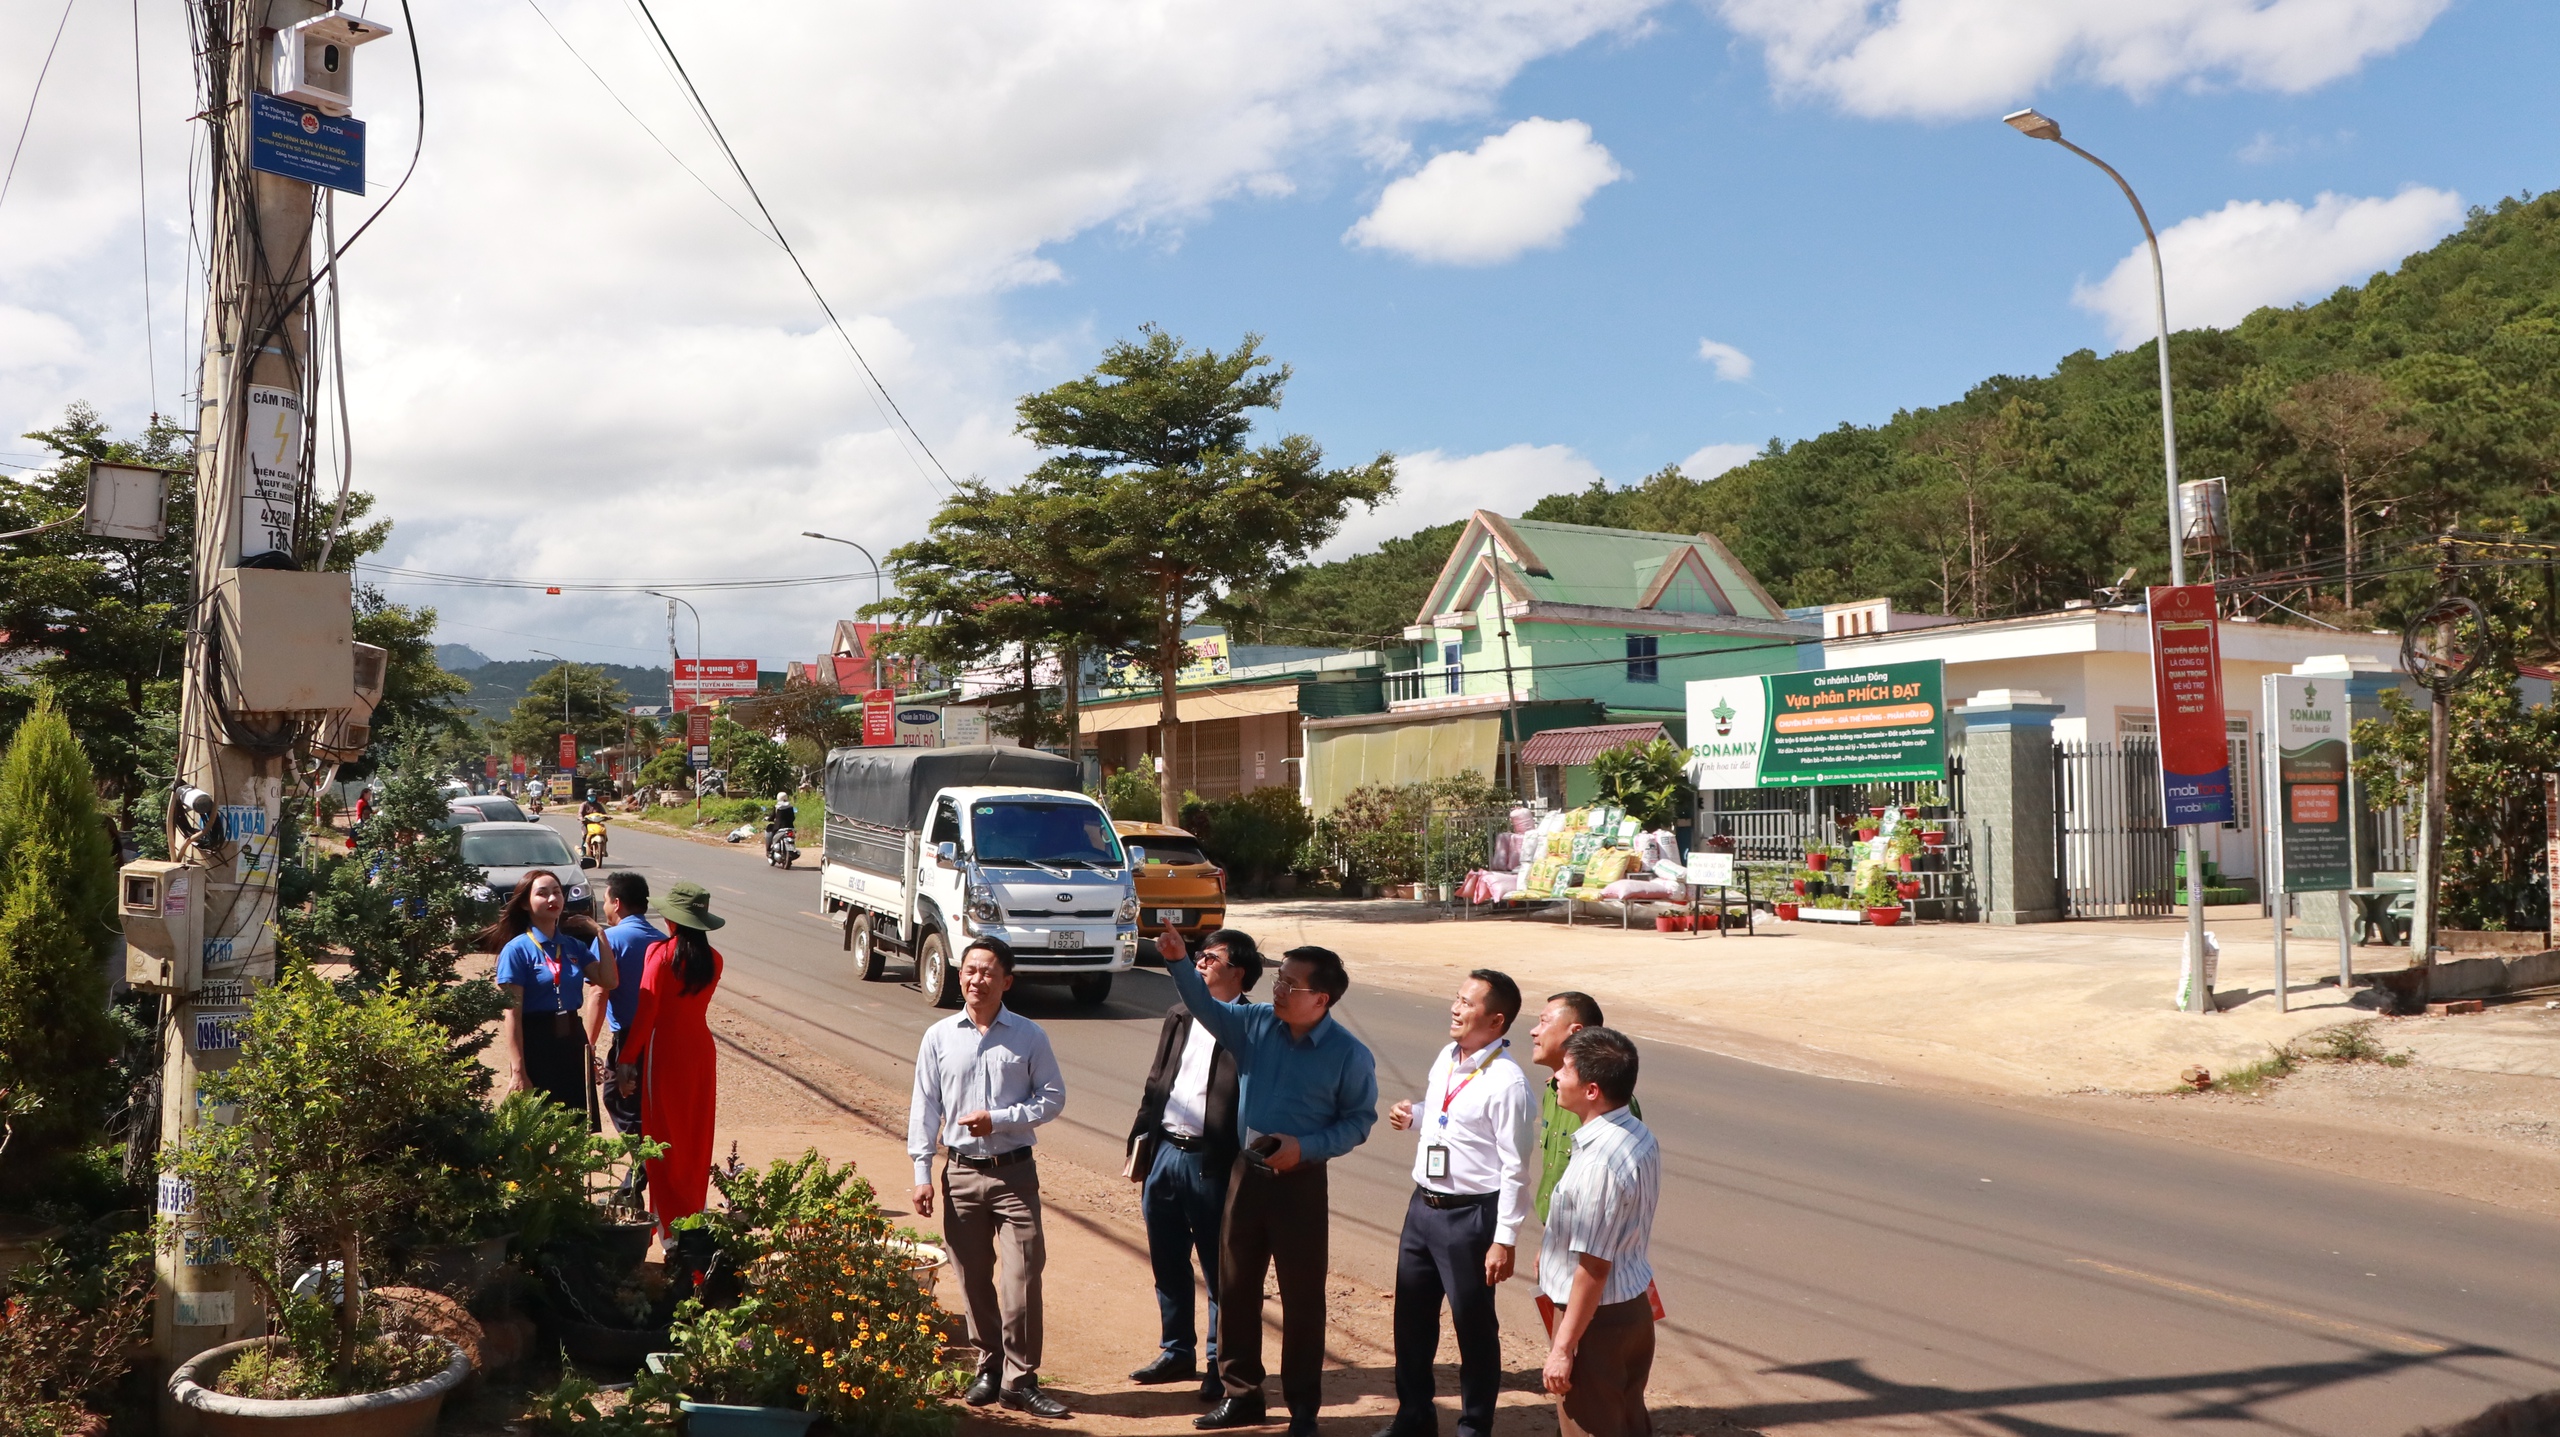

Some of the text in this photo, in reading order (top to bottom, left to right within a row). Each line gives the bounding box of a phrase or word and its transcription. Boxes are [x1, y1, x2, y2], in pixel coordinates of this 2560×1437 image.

[254, 390, 278, 406] CẤM
[278, 471, 290, 480] CAO
[2178, 658, 2195, 666] CÔNG
[707, 666, 733, 674] quang
[2169, 670, 2207, 679] QUAN TRỌNG
[1814, 672, 1888, 686] Chi nhánh Lâm Đồng
[1785, 682, 1922, 710] Vựa phân PHÍCH ĐẠT
[2178, 705, 2195, 713] CÔNG
[2290, 708, 2332, 721] SONAMIX
[924, 730, 935, 747] BÒ
[1694, 742, 1757, 757] SONAMIX
[1717, 762, 1729, 770] hoa
[2169, 783, 2226, 796] mobifone
[1060, 932, 1074, 940] 65C
